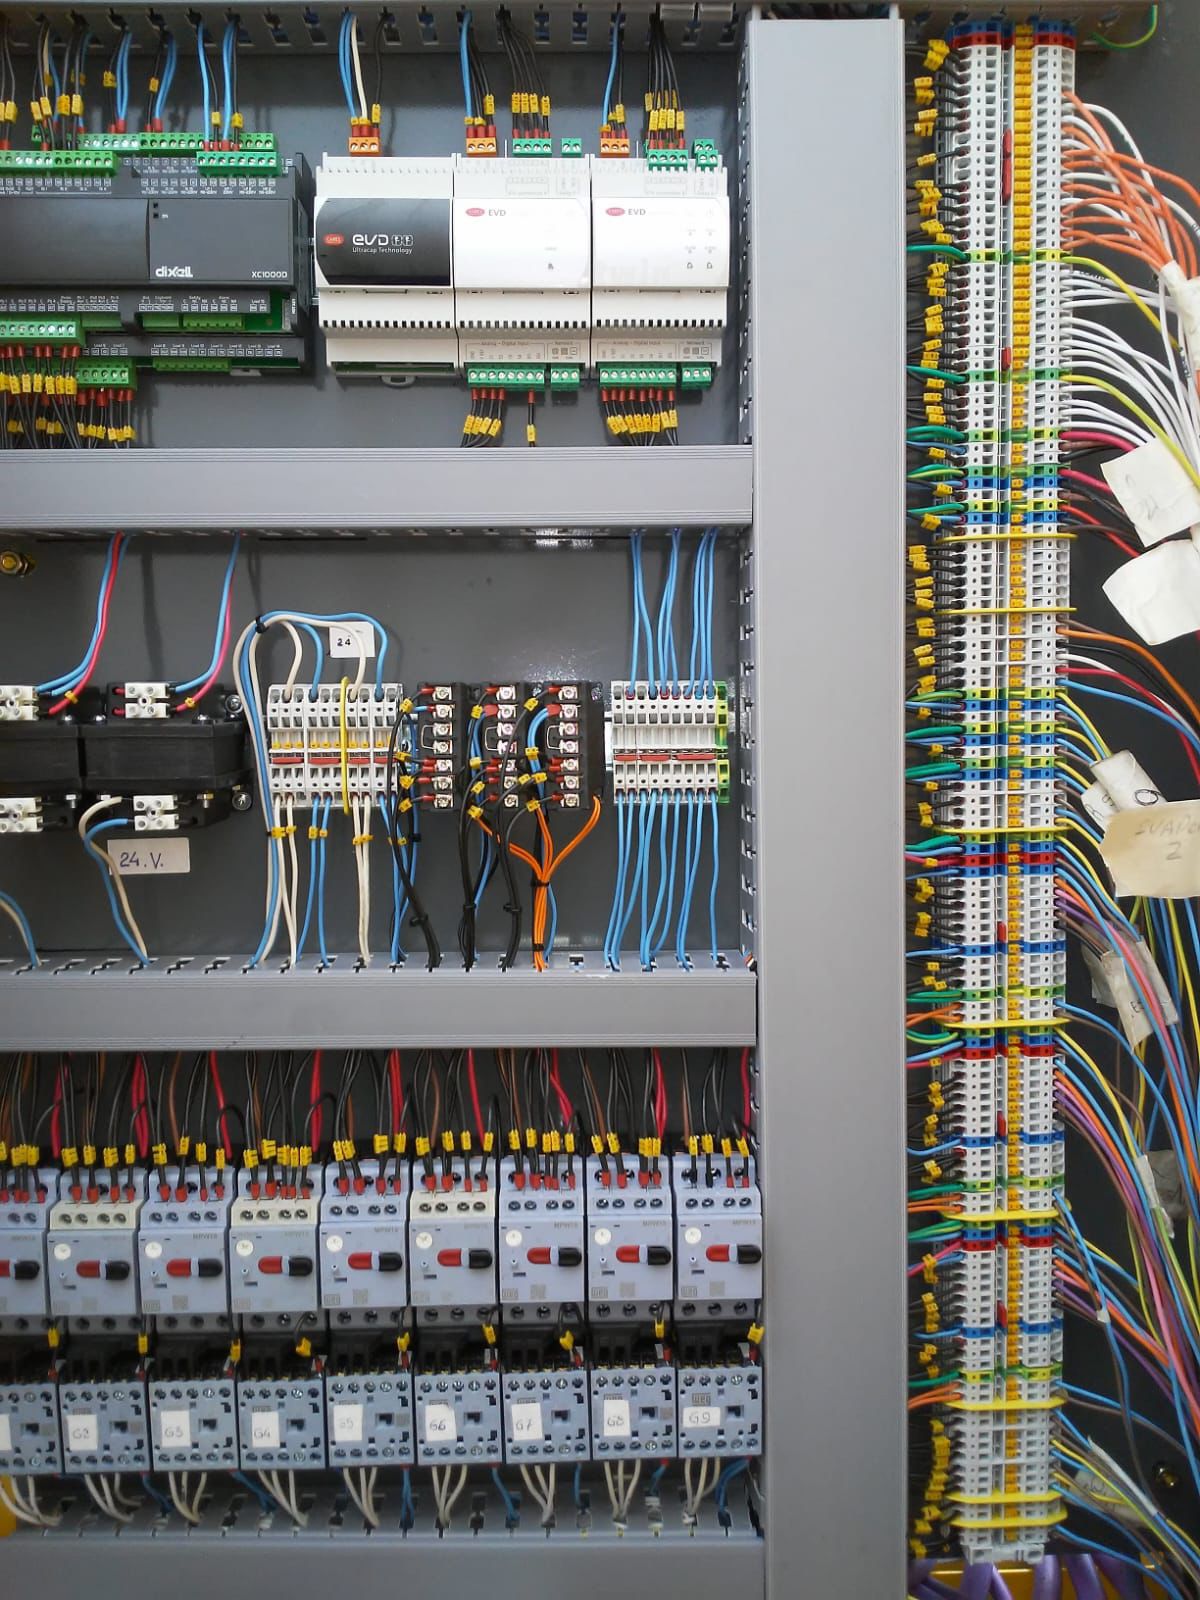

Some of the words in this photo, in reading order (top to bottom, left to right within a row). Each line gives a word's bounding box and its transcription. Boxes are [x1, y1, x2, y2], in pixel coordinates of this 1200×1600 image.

[488, 209, 507, 217] EVD
[627, 208, 647, 216] EVD
[352, 246, 377, 254] Ultracap
[378, 246, 413, 255] Technology
[337, 637, 351, 647] 24
